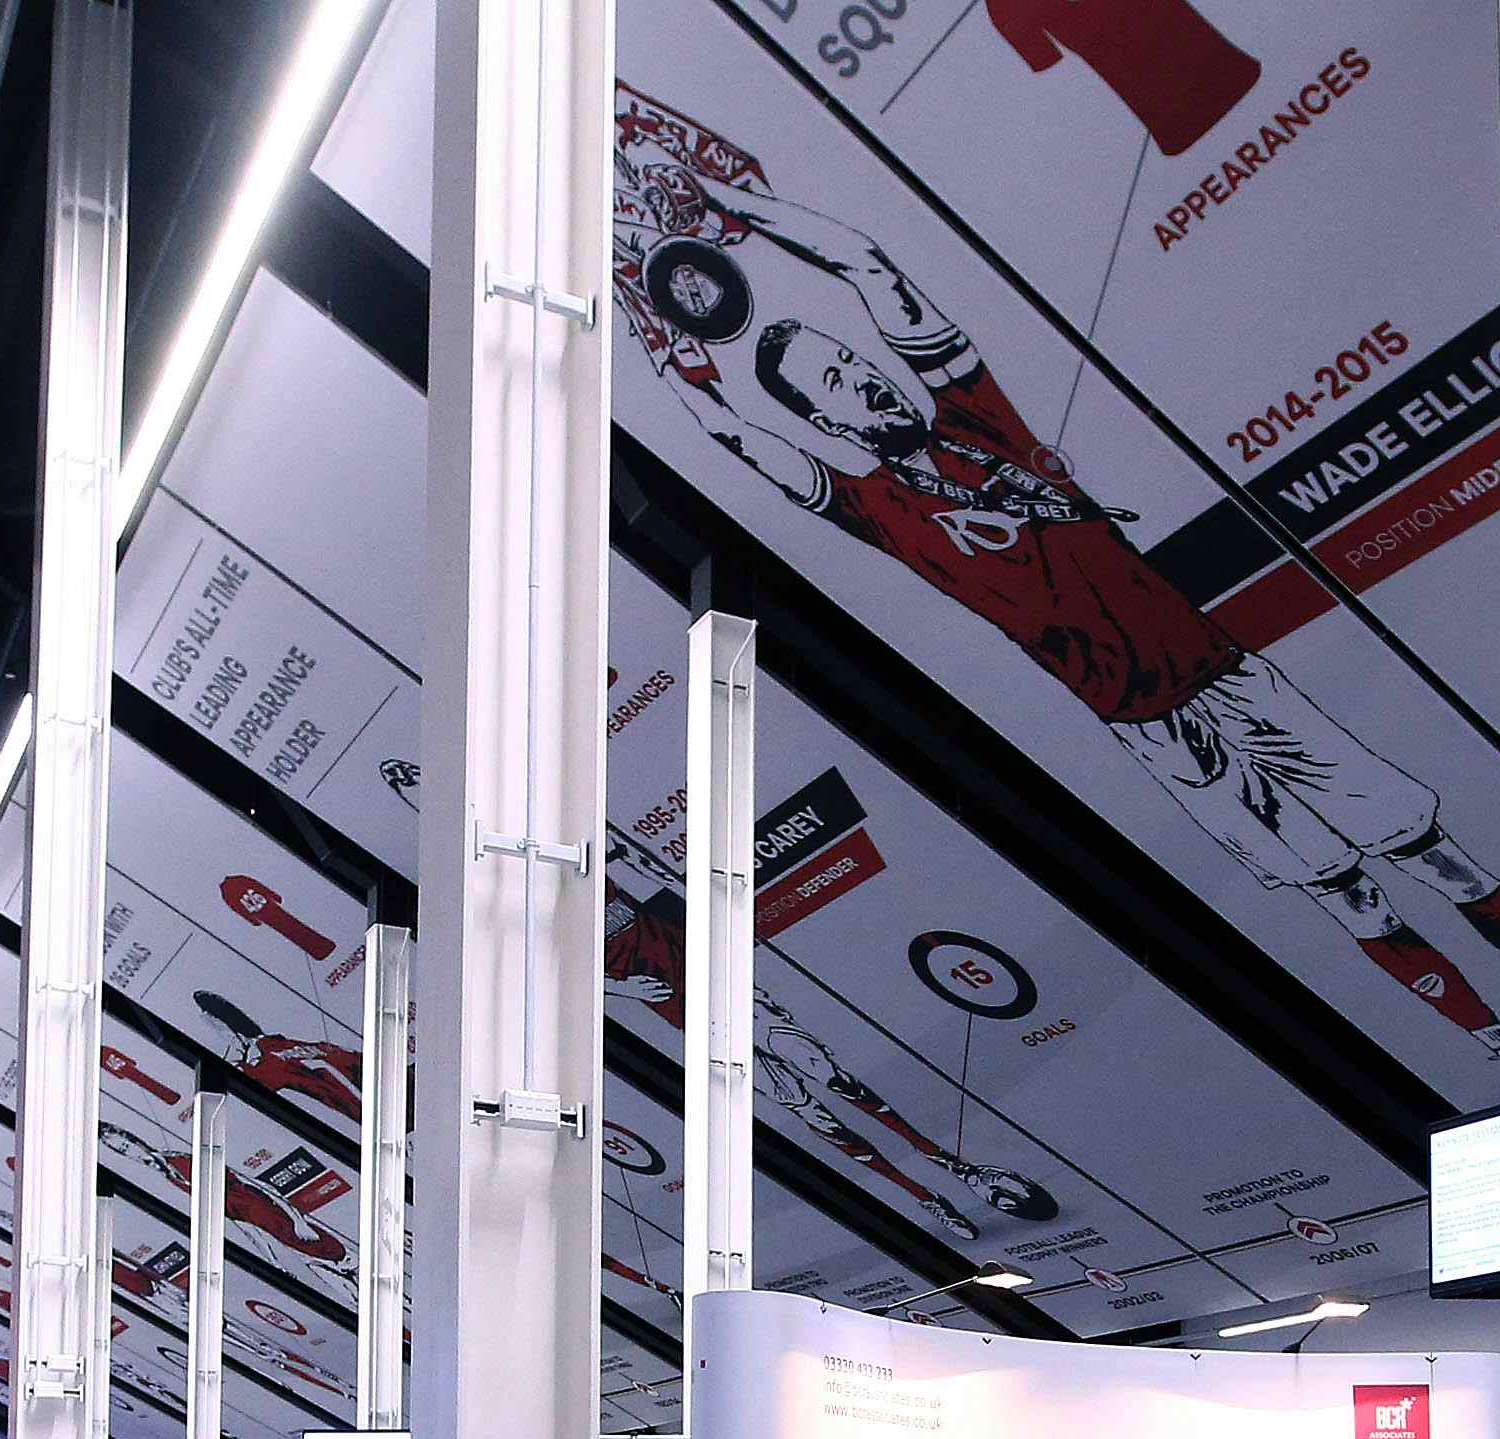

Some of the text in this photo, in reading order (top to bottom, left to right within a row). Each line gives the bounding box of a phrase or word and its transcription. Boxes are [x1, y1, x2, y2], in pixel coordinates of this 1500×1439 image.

[1152, 46, 1372, 251] APPEARANCES
[1226, 321, 1410, 463] 2014-2015
[1279, 421, 1408, 513] WADE
[1346, 497, 1455, 570] POSITION
[152, 555, 249, 701] CLUB'S ALL-TIME
[190, 656, 248, 729] LEADING
[229, 646, 317, 758] APPEARANCE
[266, 719, 326, 784] HOLDER
[759, 805, 825, 860] CAREY
[797, 856, 860, 899] DEFENDER
[951, 960, 993, 990] 15
[1021, 1018, 1077, 1049] GOALS
[1203, 1168, 1304, 1202] PROMOTION TO
[1203, 1174, 1332, 1217] THE CHAMPIONSHIP
[1004, 1226, 1100, 1257] FOOTBALL LEAGUE
[1310, 1242, 1381, 1266] 2006/07
